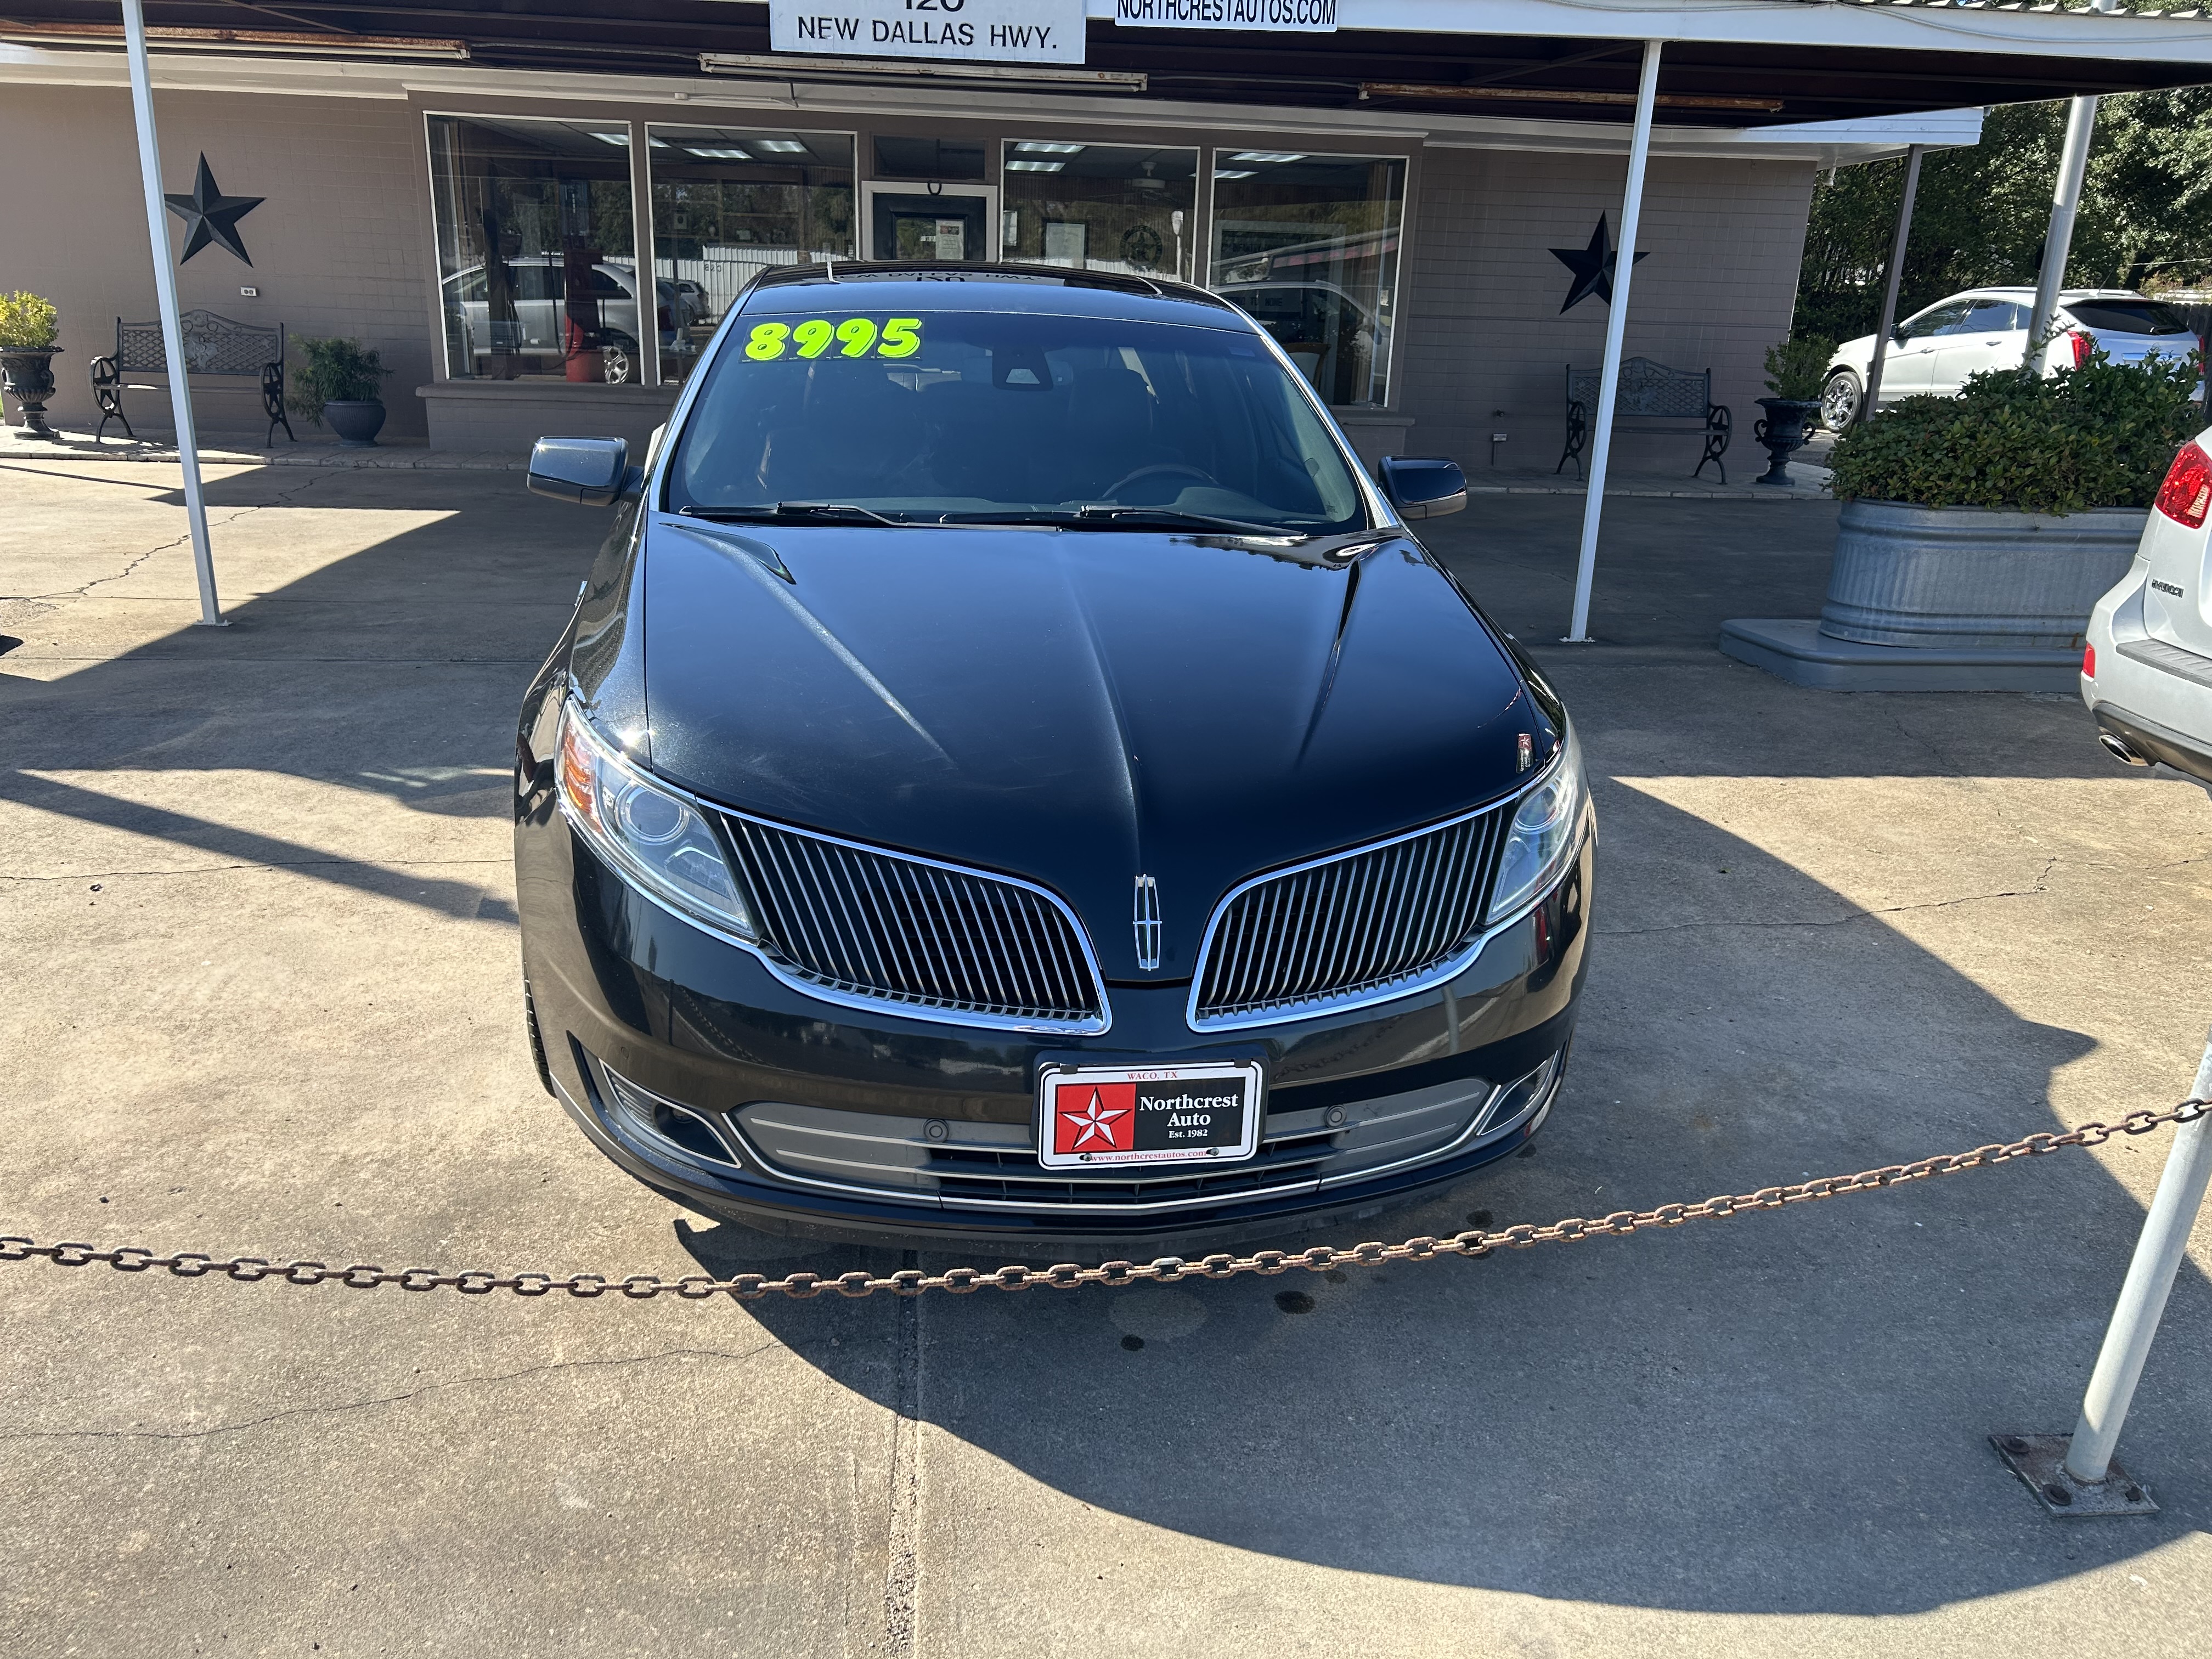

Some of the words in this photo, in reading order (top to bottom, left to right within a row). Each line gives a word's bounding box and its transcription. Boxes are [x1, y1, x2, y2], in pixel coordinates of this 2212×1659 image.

[797, 16, 860, 41] NEW
[872, 20, 975, 46] DALLAS
[990, 24, 1058, 49] HWY.
[744, 317, 923, 362] 8995
[1164, 1070, 1178, 1079] TX
[1139, 1093, 1239, 1111] Northcrest
[1166, 1111, 1211, 1127] Auto
[1168, 1130, 1186, 1139] Est.
[1187, 1128, 1209, 1138] 1982
